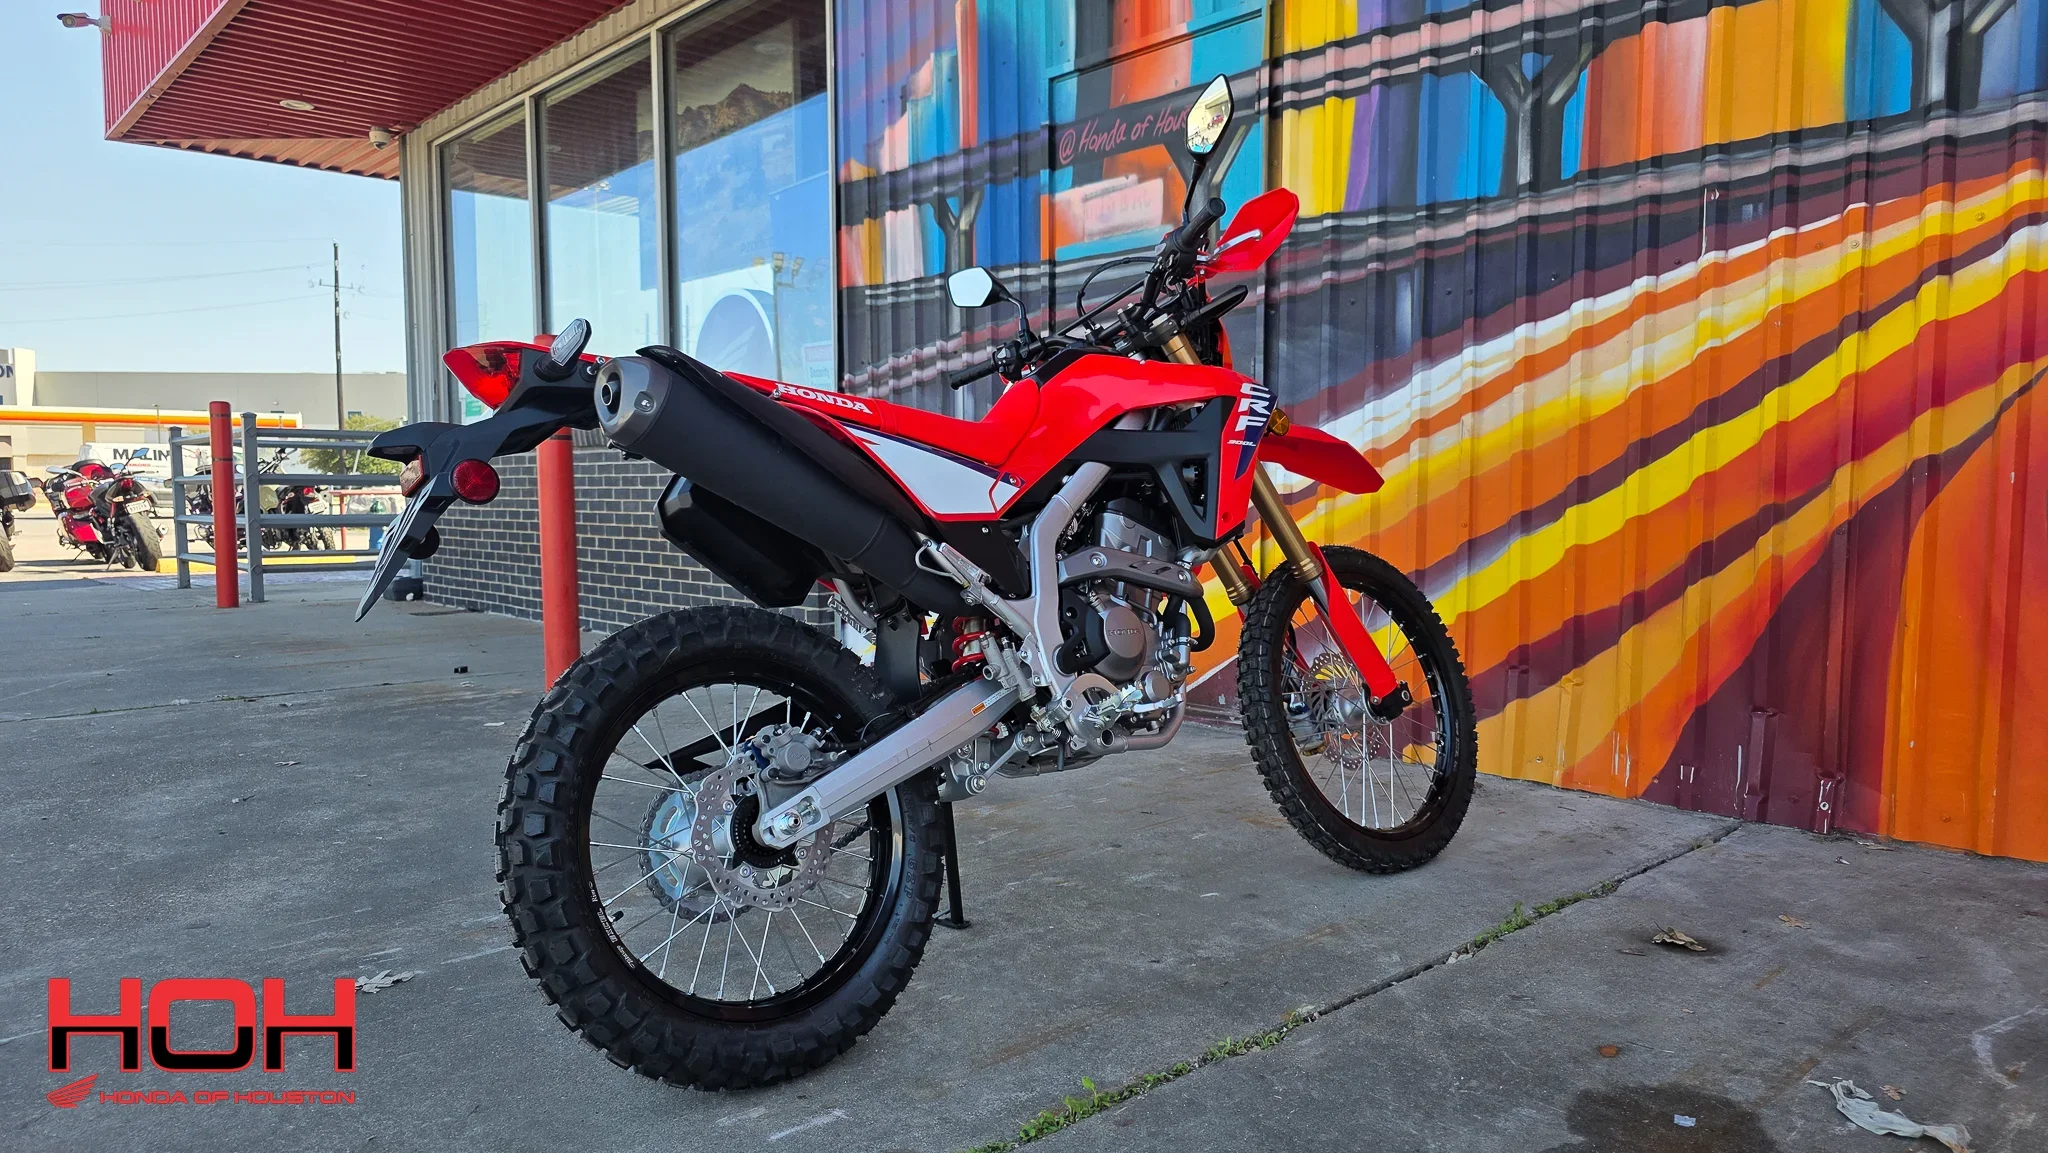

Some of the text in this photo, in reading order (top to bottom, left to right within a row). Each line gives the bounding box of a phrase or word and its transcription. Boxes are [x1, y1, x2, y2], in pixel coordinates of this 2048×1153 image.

[1059, 103, 1192, 165] @ Honda of Hous
[775, 383, 873, 415] HONDA
[1235, 382, 1271, 432] CRF
